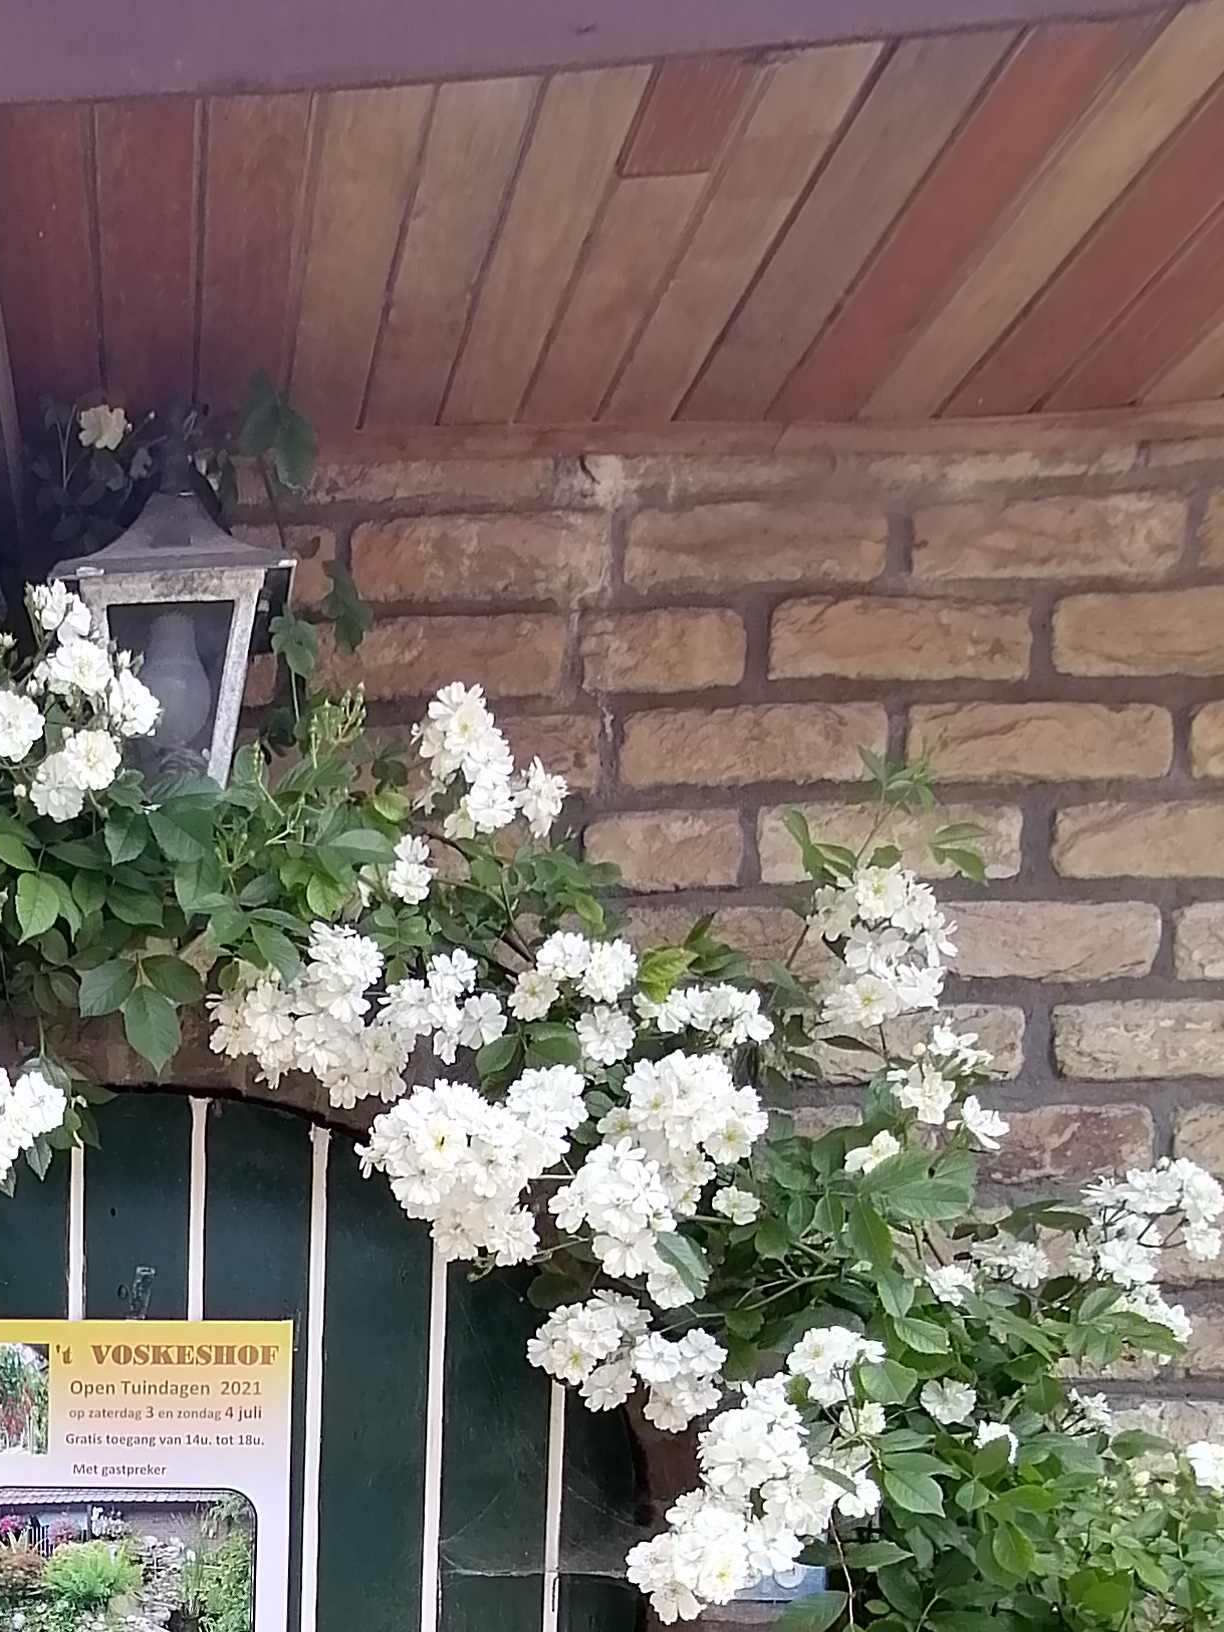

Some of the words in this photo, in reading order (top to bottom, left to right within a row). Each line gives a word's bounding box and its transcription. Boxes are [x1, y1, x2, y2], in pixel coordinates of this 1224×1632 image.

[56, 1344, 73, 1365] 't
[90, 1345, 279, 1366] VOSKESHOF
[70, 1381, 115, 1397] Open
[121, 1381, 210, 1398] Tuindagen
[220, 1381, 262, 1396] 2021
[69, 1410, 85, 1420] op
[88, 1408, 142, 1421] zaterdag
[145, 1406, 155, 1419] 3
[158, 1410, 174, 1419] en
[177, 1408, 222, 1421] zondag
[224, 1407, 234, 1419] 4
[238, 1406, 262, 1422] juli
[65, 1433, 102, 1445] Gratis
[106, 1434, 156, 1447] toegang
[159, 1436, 182, 1446] van
[186, 1434, 212, 1446] 14u.
[216, 1435, 234, 1446] tot
[239, 1434, 265, 1446] 18u.
[73, 1463, 98, 1475] Met
[101, 1464, 167, 1477] gastpreker
